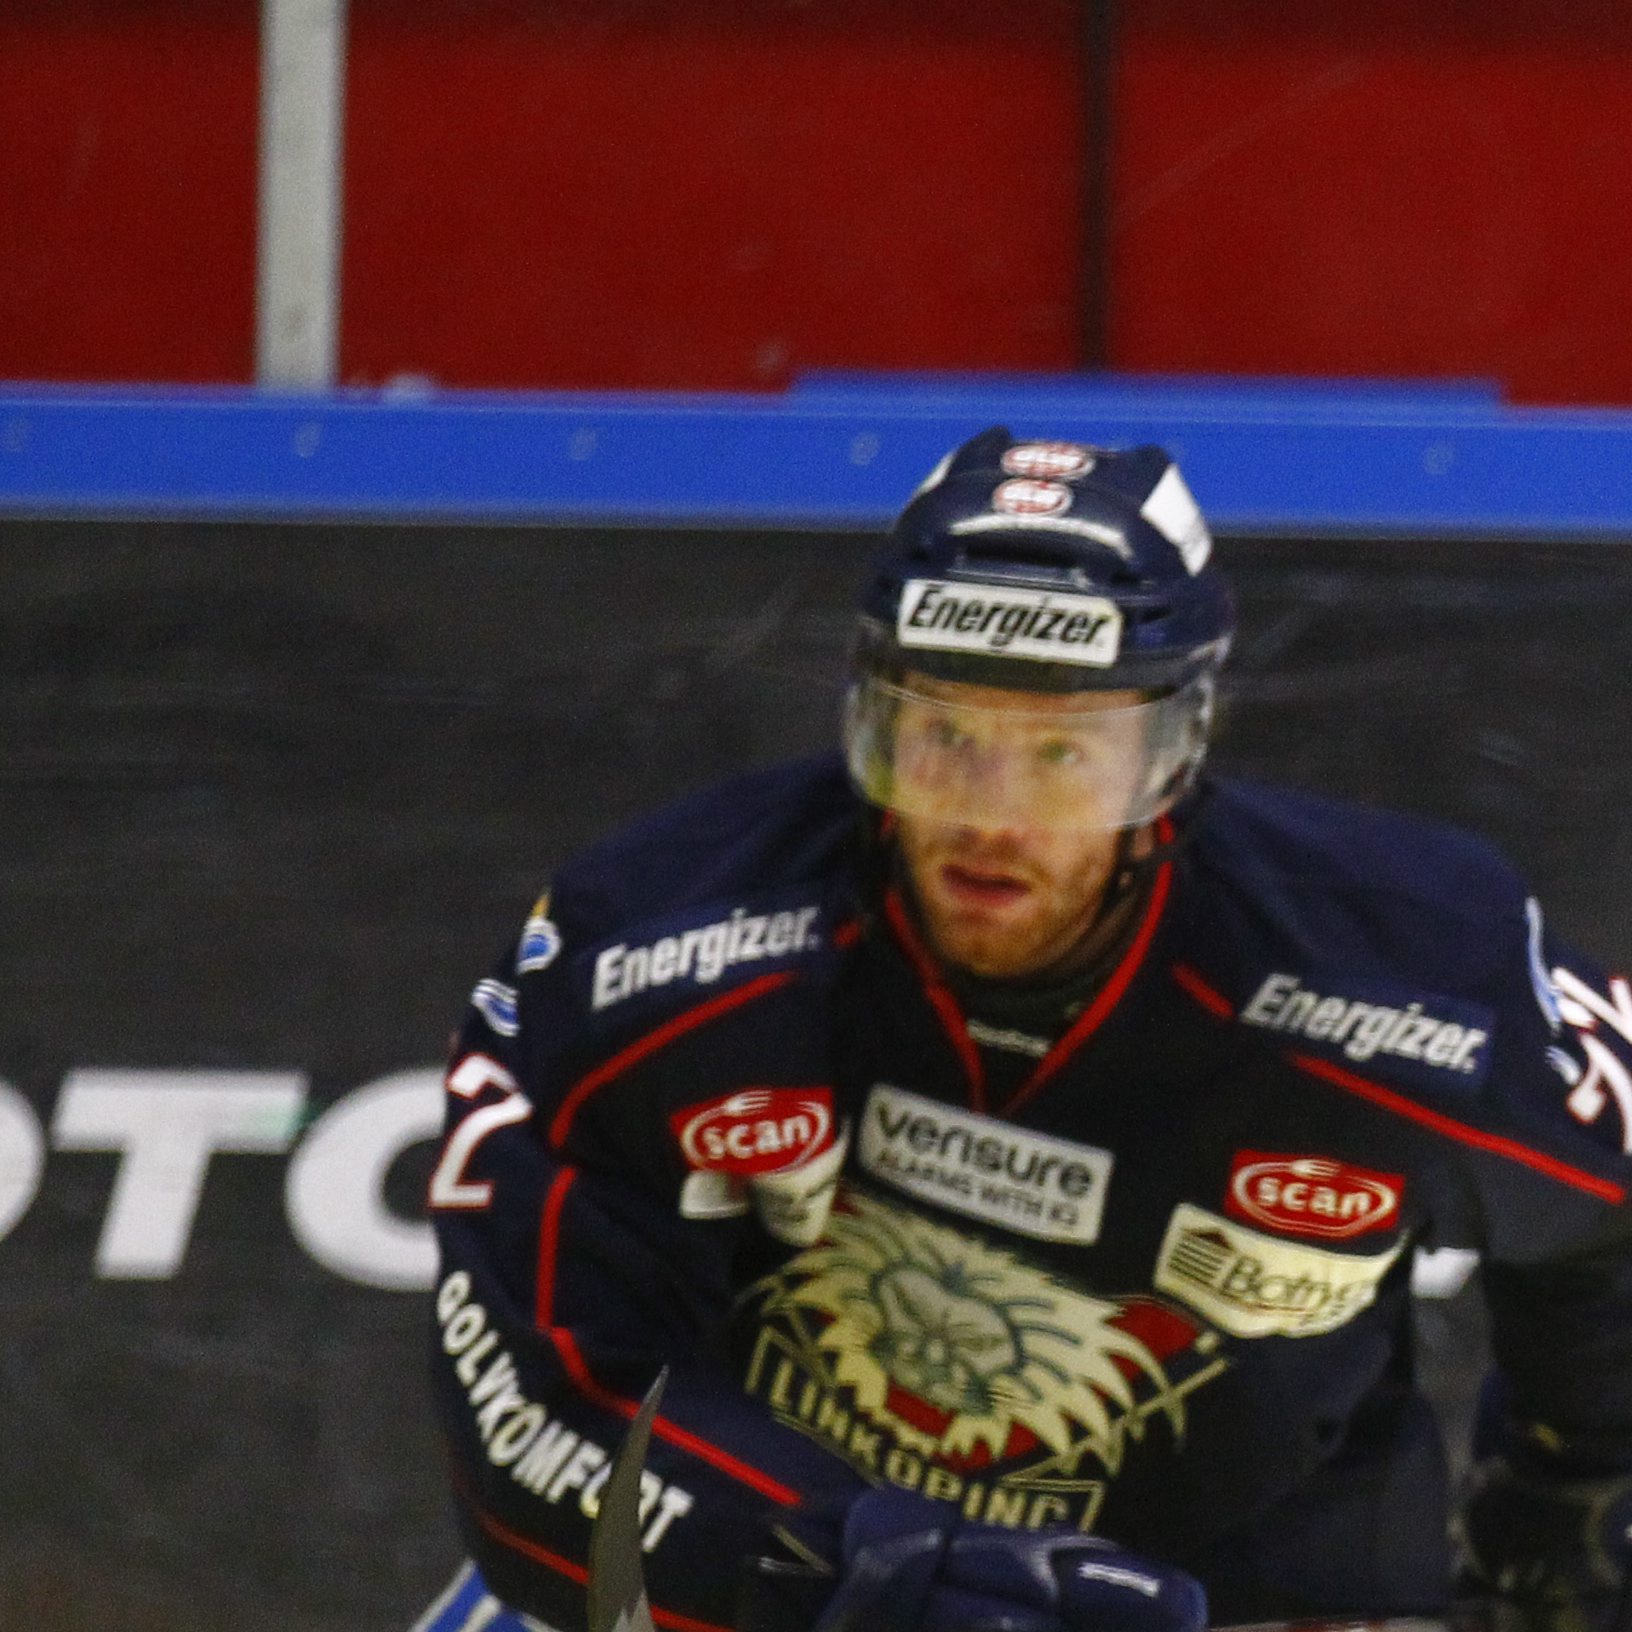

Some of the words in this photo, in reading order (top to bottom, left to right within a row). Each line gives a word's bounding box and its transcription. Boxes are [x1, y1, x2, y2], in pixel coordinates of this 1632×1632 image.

[908, 588, 1111, 650] Energizer
[592, 906, 816, 1010] Energizer
[1240, 971, 1487, 1074] Energizer
[699, 1111, 811, 1161] scan
[1257, 1176, 1372, 1219] scan
